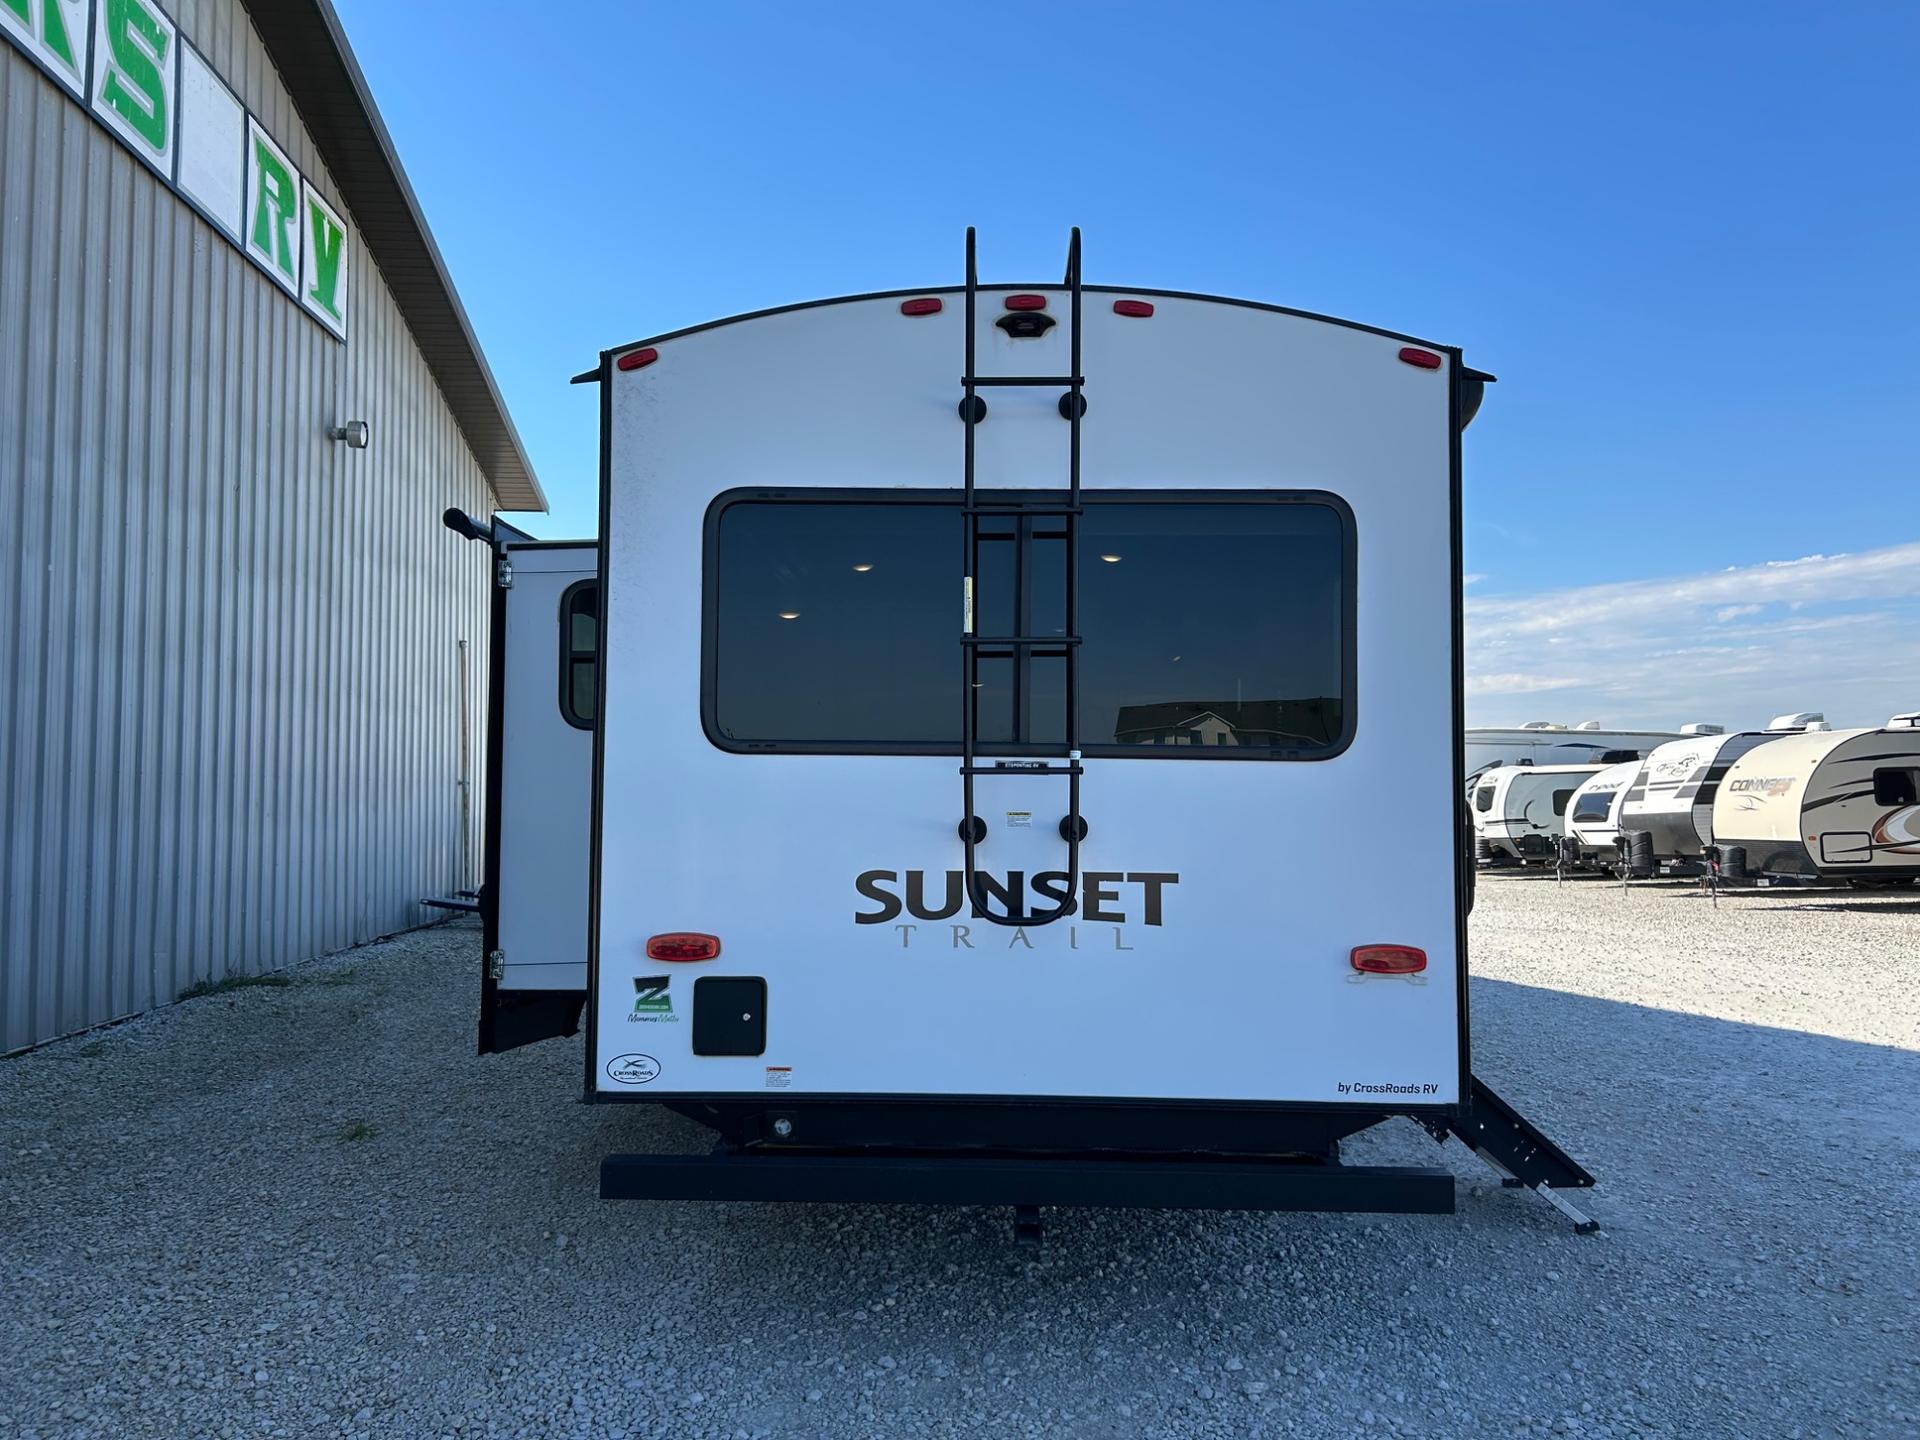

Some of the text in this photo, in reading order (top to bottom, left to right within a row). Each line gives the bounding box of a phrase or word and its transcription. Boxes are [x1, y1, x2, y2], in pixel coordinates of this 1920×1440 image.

[855, 869, 1179, 926] SUNSET
[895, 924, 1134, 950] TRAIL
[1338, 1082, 1438, 1095] by CrossRoads RV
